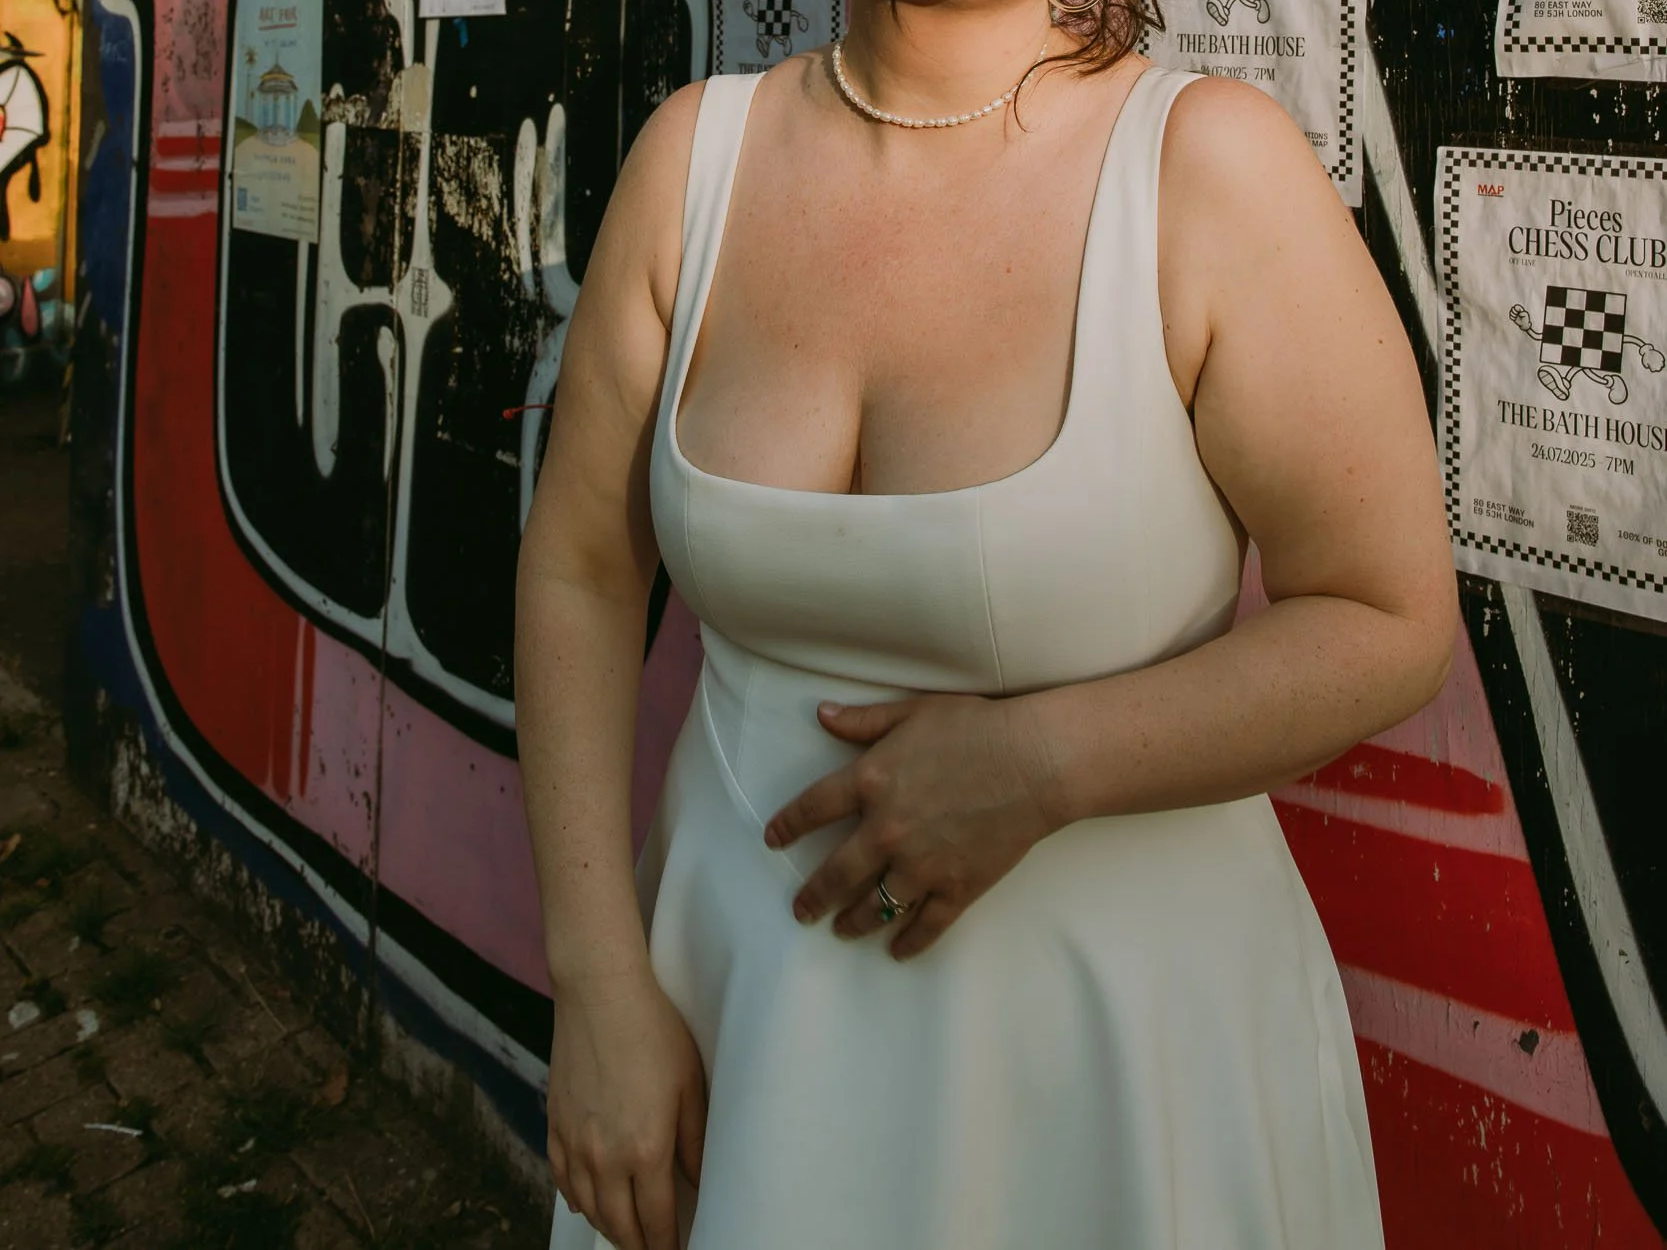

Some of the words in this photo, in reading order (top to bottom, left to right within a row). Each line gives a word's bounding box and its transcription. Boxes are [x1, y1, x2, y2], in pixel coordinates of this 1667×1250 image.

[1534, 1, 1546, 10] 80
[1548, 1, 1569, 10] EAST
[1571, 0, 1593, 9] WAY
[1534, 9, 1544, 18] E9
[1547, 9, 1565, 18] 5JH
[1567, 9, 1604, 18] LONDON
[1177, 33, 1206, 53] THE
[1209, 33, 1250, 55] BATH
[1253, 35, 1306, 57] HOUSE
[1254, 67, 1276, 81] 7PM
[1312, 140, 1329, 148] MAP
[1477, 183, 1505, 195] MAP
[1549, 198, 1623, 233] Pieces
[1508, 226, 1589, 261] CHESS
[1596, 234, 1667, 268] CLUB
[1497, 399, 1539, 430] THE
[1542, 407, 1601, 440] BATH
[1531, 442, 1597, 469] 24.07.2025
[1605, 455, 1635, 476] 7PM
[1473, 498, 1484, 508] 80
[1486, 500, 1507, 512] EAST
[1508, 505, 1526, 517] WAY
[1473, 506, 1484, 516] E9
[1486, 509, 1503, 520] 5JH
[1504, 513, 1535, 528] LONDON
[1618, 530, 1641, 543] 100%
[1642, 535, 1654, 545] OF
